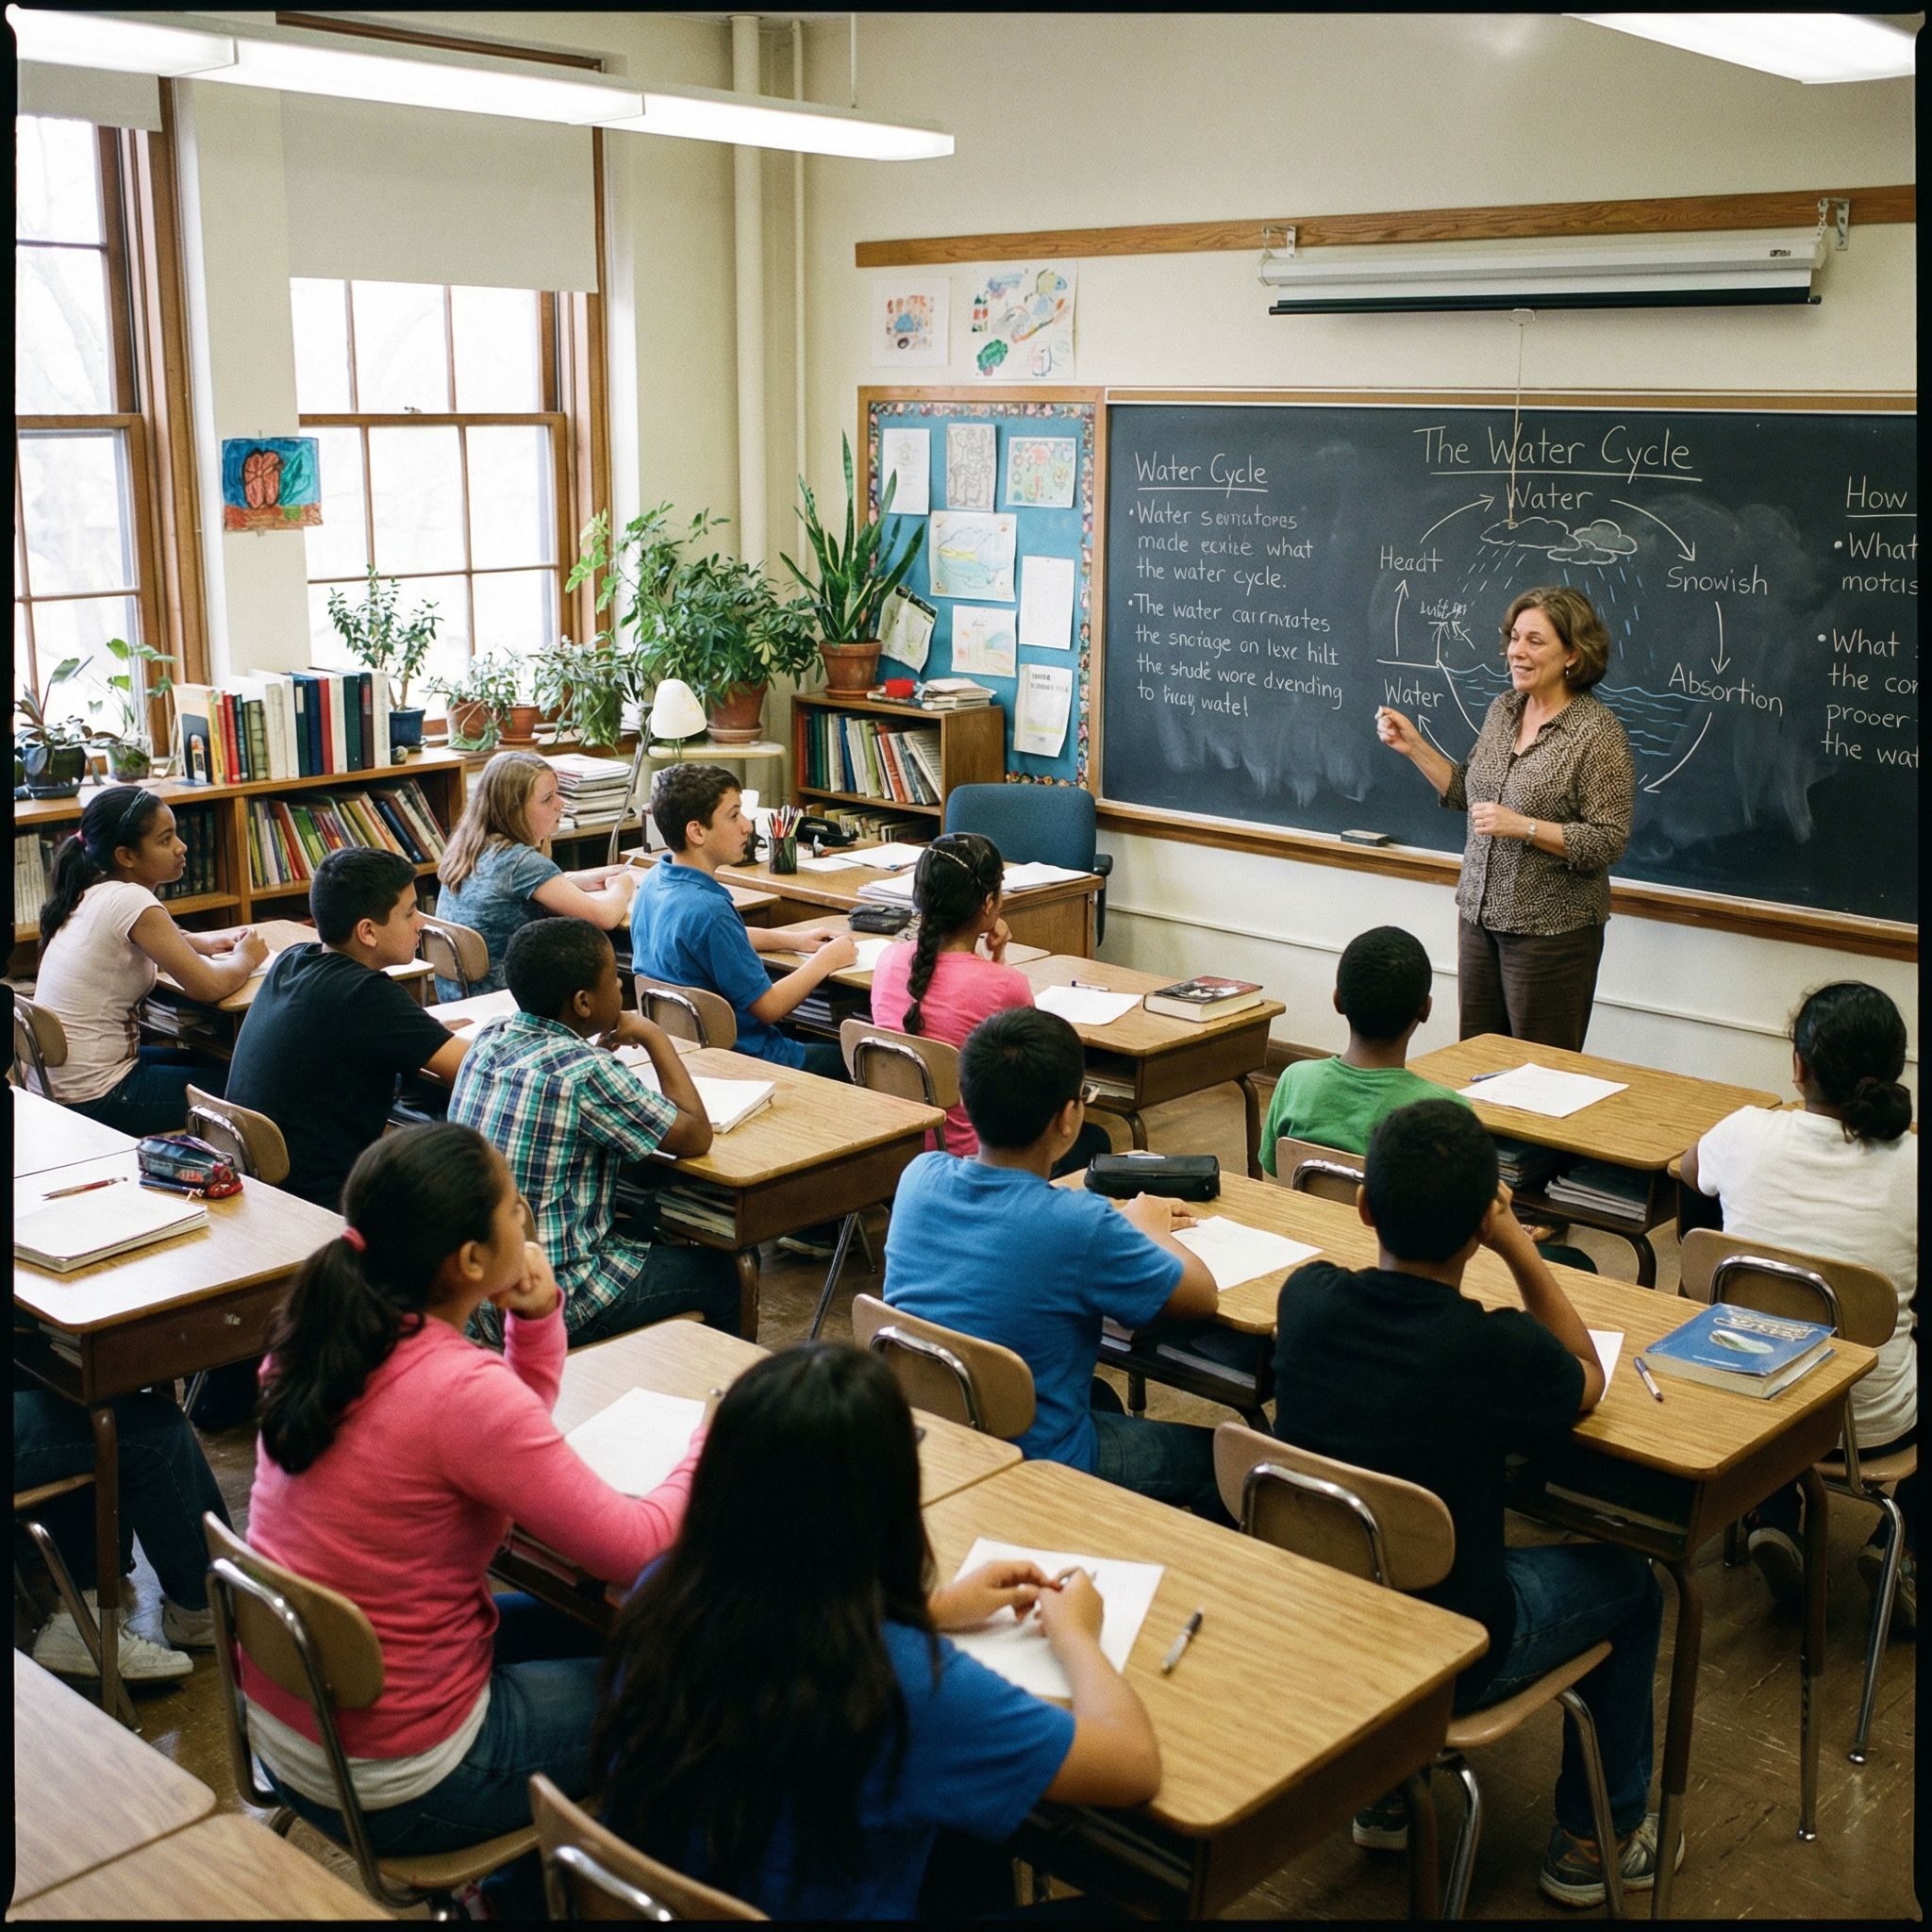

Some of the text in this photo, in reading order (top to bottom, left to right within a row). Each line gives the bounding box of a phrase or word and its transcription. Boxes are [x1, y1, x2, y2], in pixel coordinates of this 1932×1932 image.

[1412, 422, 1695, 484] The Water Cycle
[1135, 451, 1269, 498] Water Cycle
[1507, 481, 1593, 510] Water
[1845, 475, 1908, 508] How
[1137, 499, 1192, 524] Water
[1138, 531, 1189, 553] made
[1266, 536, 1313, 558] what
[1848, 531, 1919, 560] What
[1136, 557, 1287, 597] the water cycle.
[1666, 564, 1769, 596] Snowish
[1133, 593, 1165, 616] The
[1173, 598, 1223, 620] water
[1135, 624, 1161, 645] the
[1240, 641, 1259, 655] on
[1832, 627, 1901, 658] What
[1136, 652, 1165, 675] the
[1217, 670, 1257, 687] wore
[1826, 662, 1870, 691] the
[1137, 678, 1155, 701] to
[1385, 678, 1445, 708] Water
[1668, 662, 1784, 717] Absortion
[1820, 731, 1862, 760] the
